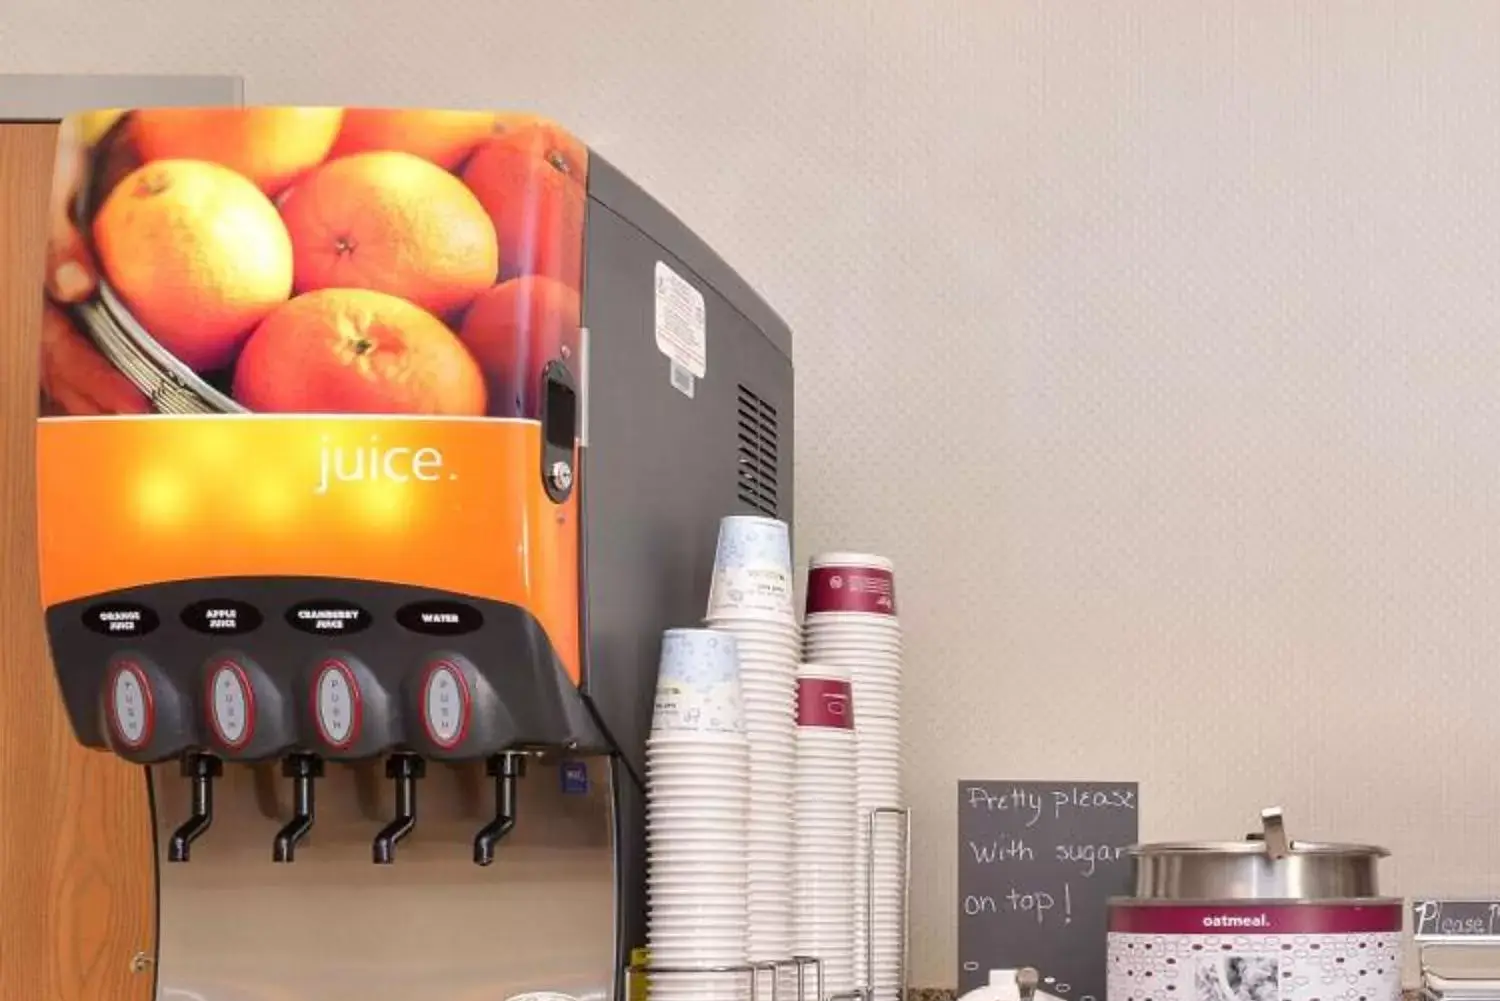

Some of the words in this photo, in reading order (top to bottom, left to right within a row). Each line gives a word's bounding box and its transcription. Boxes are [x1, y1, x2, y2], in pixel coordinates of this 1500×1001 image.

[313, 434, 458, 495] juice.
[100, 611, 140, 621] ORANGE
[206, 609, 237, 619] APPLE
[298, 610, 359, 619] CRANBERRY
[421, 613, 460, 623] WATER
[110, 622, 135, 631] JUICE
[209, 619, 236, 628] JUICE
[316, 620, 344, 629] JUICE
[966, 787, 1041, 828] Pretty
[1052, 787, 1135, 819] please
[1055, 844, 1124, 877] sugar
[963, 893, 997, 915] on
[1203, 912, 1271, 927] oatmeal.
[1415, 900, 1484, 936] Please
